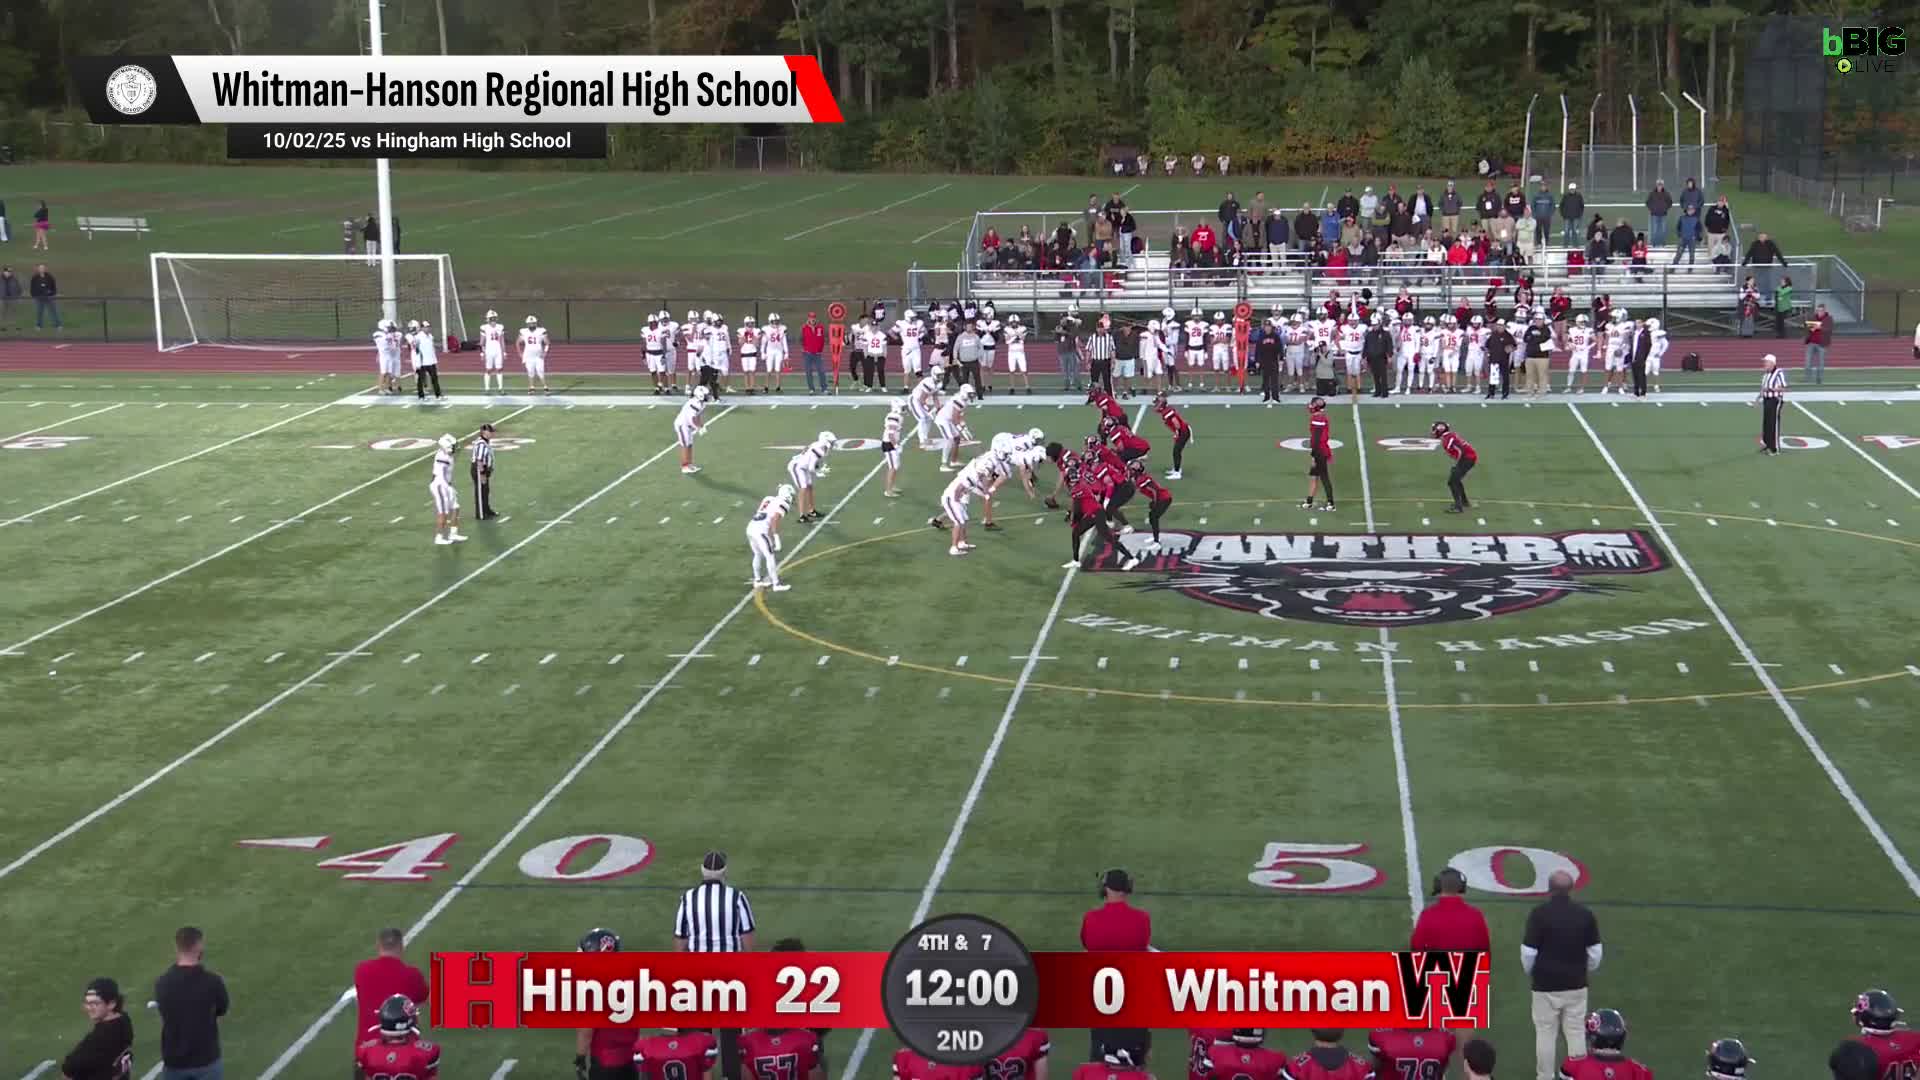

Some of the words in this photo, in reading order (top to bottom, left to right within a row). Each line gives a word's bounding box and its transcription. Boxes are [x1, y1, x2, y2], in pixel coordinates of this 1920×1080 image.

[1319, 328, 1328, 338] 85
[871, 338, 880, 348] 52
[1064, 613, 1399, 651] WHITMAN
[1436, 618, 1710, 652] HANSON
